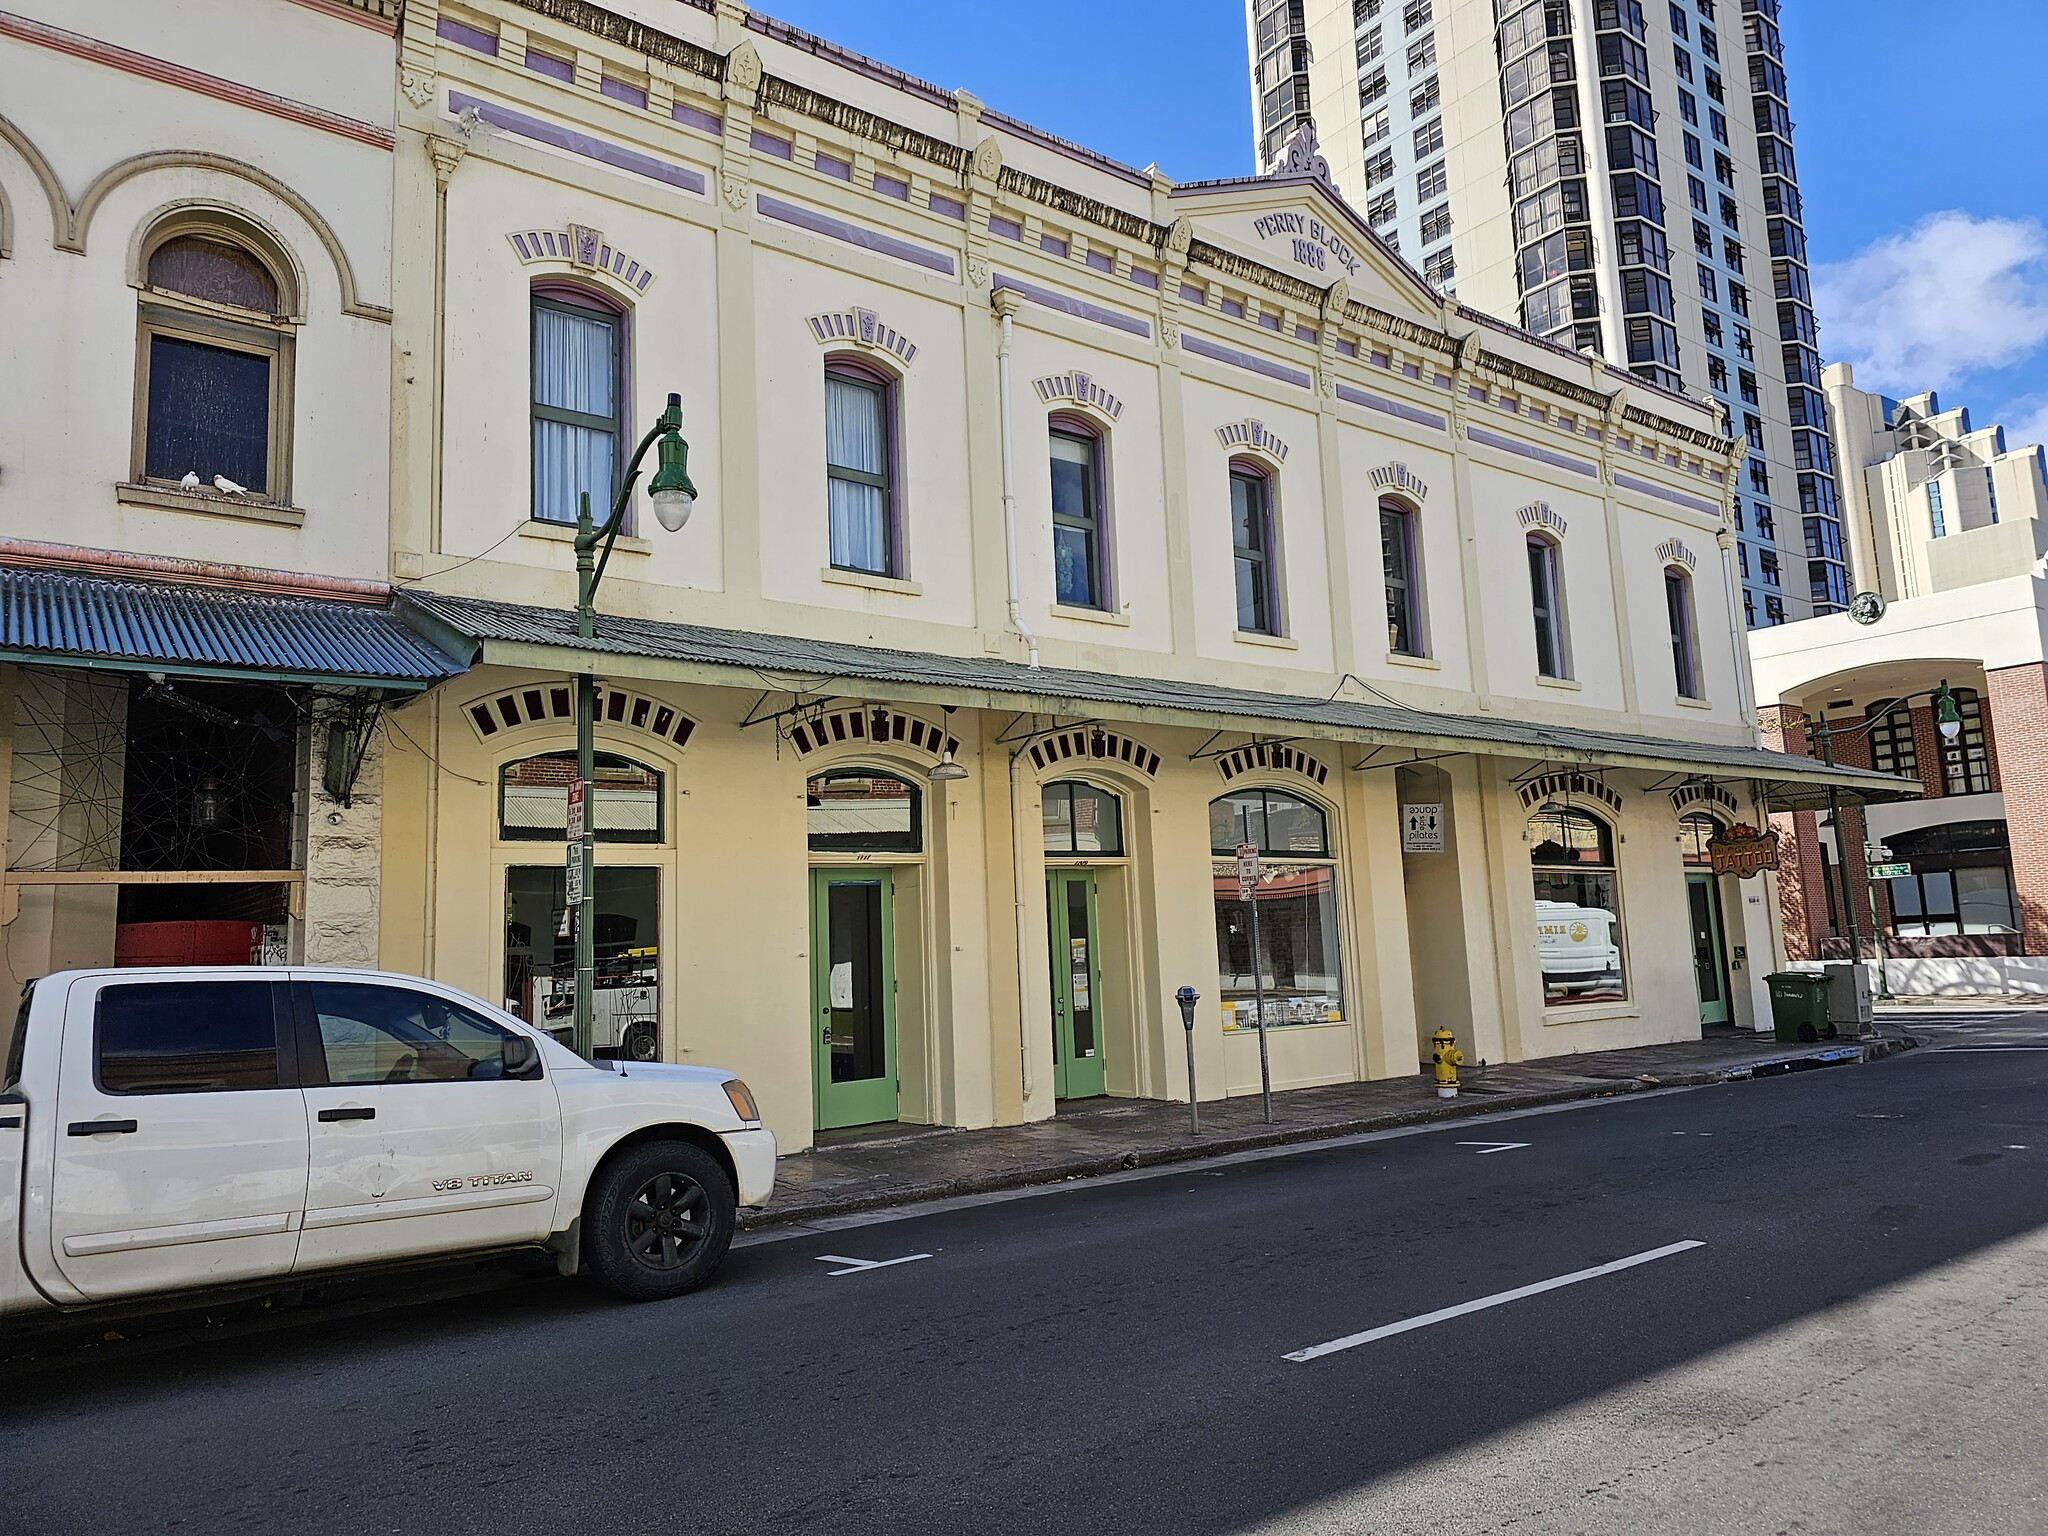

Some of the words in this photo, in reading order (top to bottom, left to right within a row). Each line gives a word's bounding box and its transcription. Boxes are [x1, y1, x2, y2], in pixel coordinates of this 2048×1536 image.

[1253, 212, 1305, 240] PERRY
[1310, 219, 1361, 276] BLOCK
[1292, 238, 1327, 271] 1888
[1409, 807, 1438, 815] dance
[1409, 831, 1438, 841] pilates
[1716, 849, 1774, 869] TATTOO
[432, 1178, 463, 1191] V8
[468, 1170, 533, 1188] TITAN
